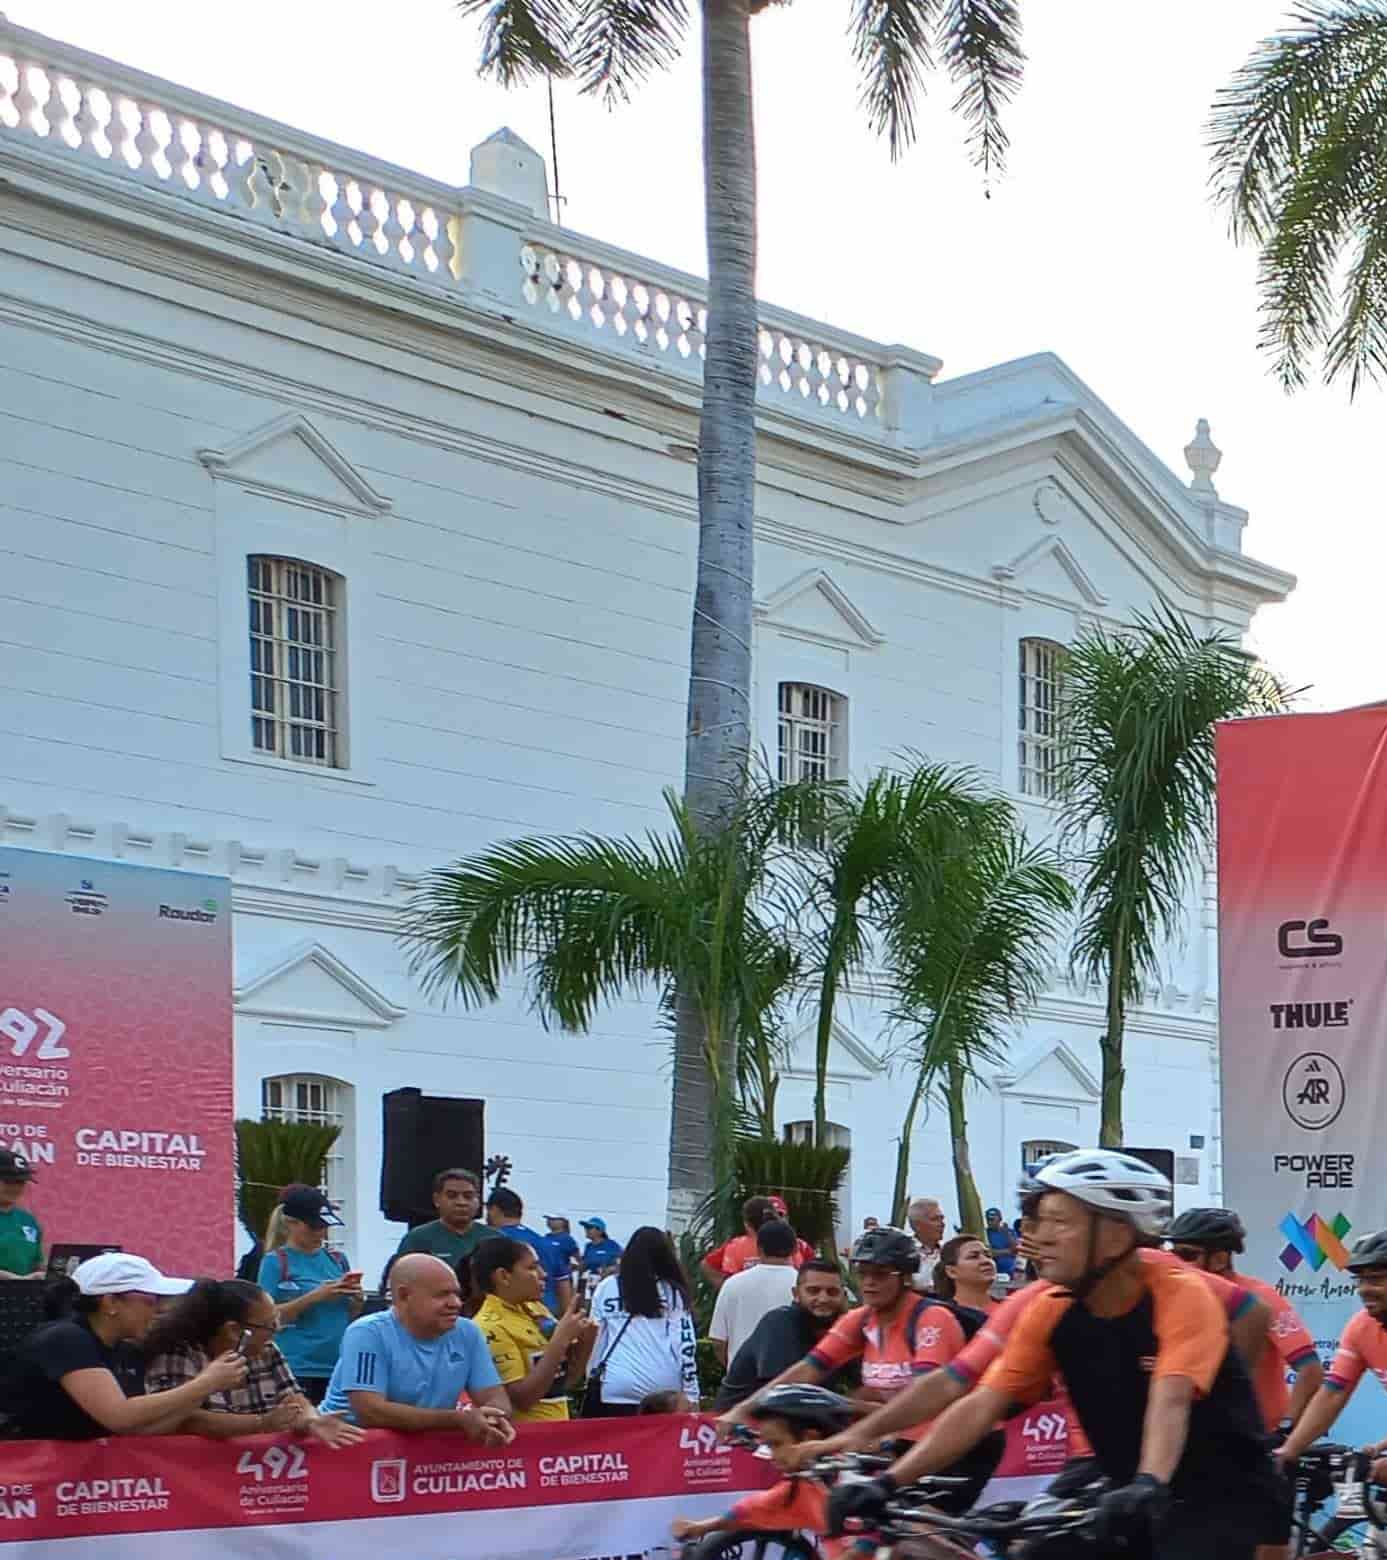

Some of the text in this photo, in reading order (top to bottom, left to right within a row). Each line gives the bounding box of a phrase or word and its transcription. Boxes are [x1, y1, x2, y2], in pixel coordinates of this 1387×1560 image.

[1278, 919, 1343, 958] CS
[1270, 1001, 1349, 1028] THULE
[24, 1125, 47, 1137] DE
[75, 1128, 206, 1156] CAPITAL
[77, 1152, 201, 1170] DE BIENESTAR
[1274, 1155, 1354, 1173] POWER
[1306, 1172, 1353, 1188] ADE
[1022, 1413, 1068, 1442] 492
[237, 1445, 308, 1481] 492
[414, 1458, 524, 1474] AYUNTAMIENTO DE
[539, 1453, 628, 1474] CAPITAL
[56, 1478, 171, 1501] CAPITAL
[413, 1470, 526, 1496] CULIACÁN
[540, 1471, 628, 1487] DE BIENESTAR
[57, 1499, 169, 1517] DE BIENESTAR
